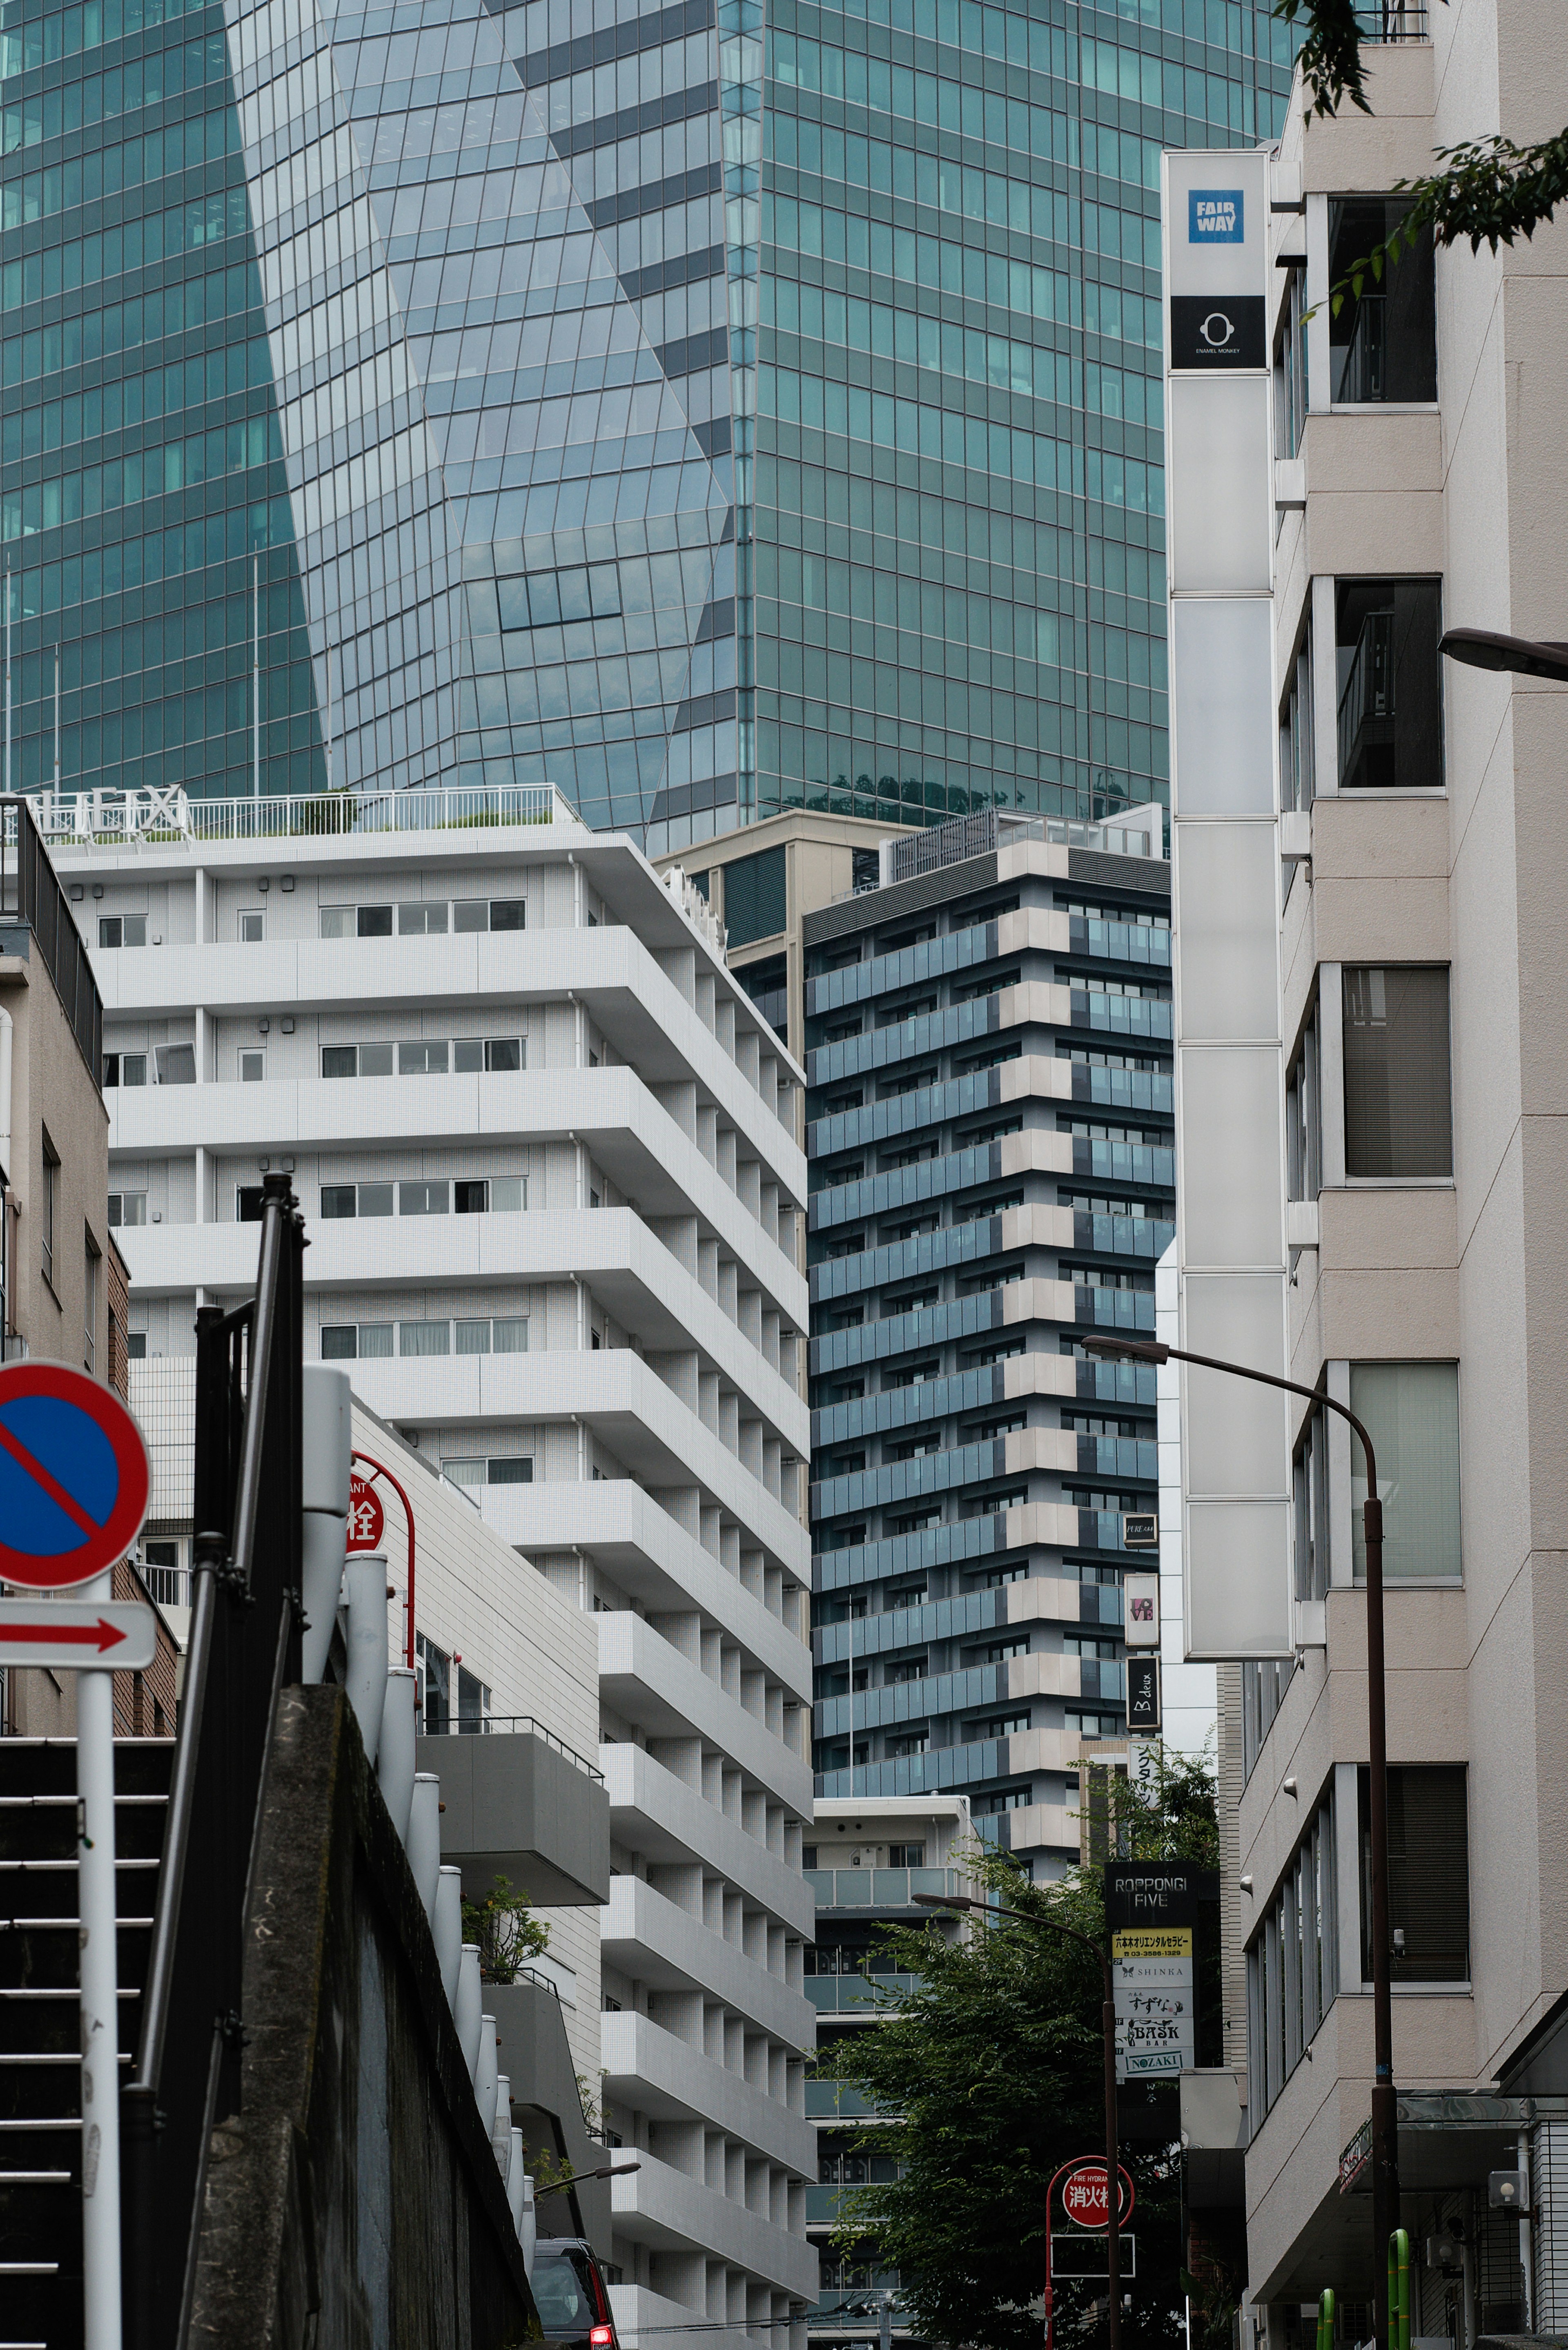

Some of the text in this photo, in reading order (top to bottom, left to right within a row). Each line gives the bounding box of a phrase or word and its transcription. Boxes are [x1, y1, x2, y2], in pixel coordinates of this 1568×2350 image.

[1197, 202, 1235, 216] FAIR
[1197, 216, 1236, 231] WAY
[1139, 1673, 1152, 1698] deux
[1116, 1877, 1187, 1892] ROPPONGI
[1135, 1893, 1167, 1907] FIVE
[1116, 1936, 1188, 1948] 六本木オリエンタルセラピー
[1134, 2027, 1179, 2039] BASK
[1132, 2055, 1177, 2069] NOZAKI
